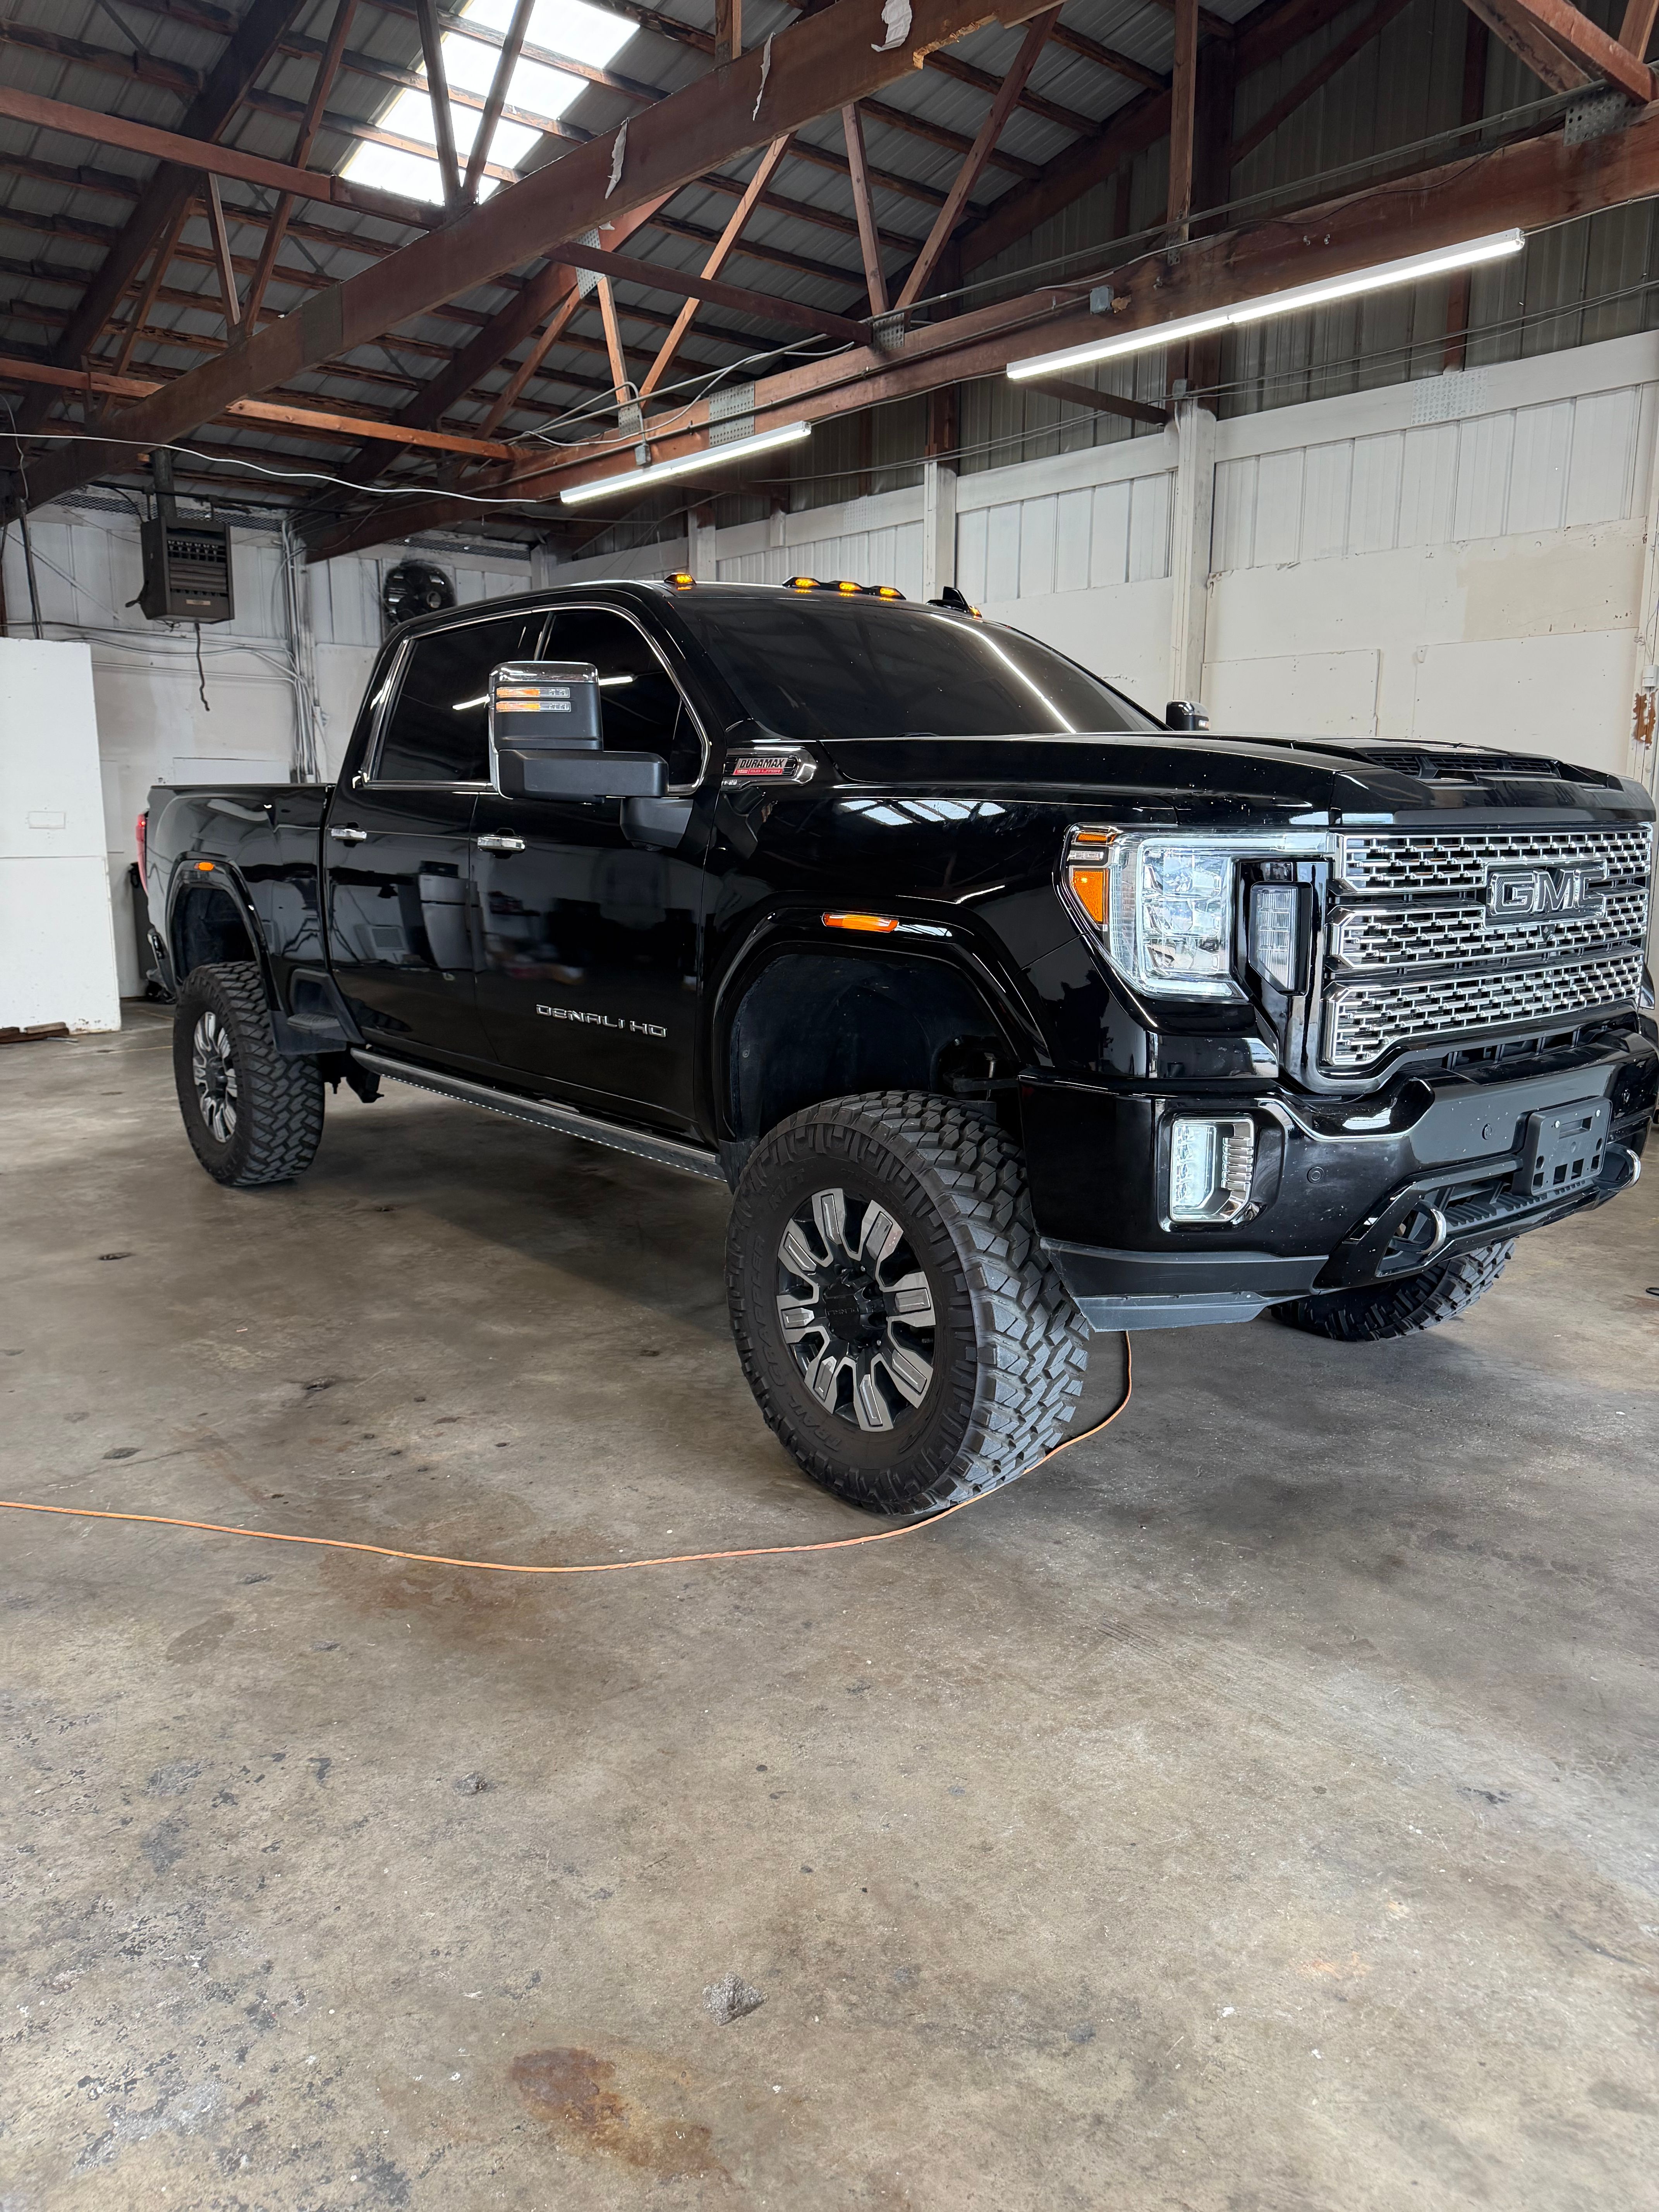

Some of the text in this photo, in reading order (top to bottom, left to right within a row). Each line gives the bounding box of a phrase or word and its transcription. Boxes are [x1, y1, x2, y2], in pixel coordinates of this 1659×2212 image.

[739, 759, 784, 768] DURAMAX
[1491, 867, 1605, 916] GMC
[536, 1004, 668, 1038] DENALI HD
[750, 1235, 785, 1387] GRAPPLER
[787, 1395, 842, 1452] TRAIL
